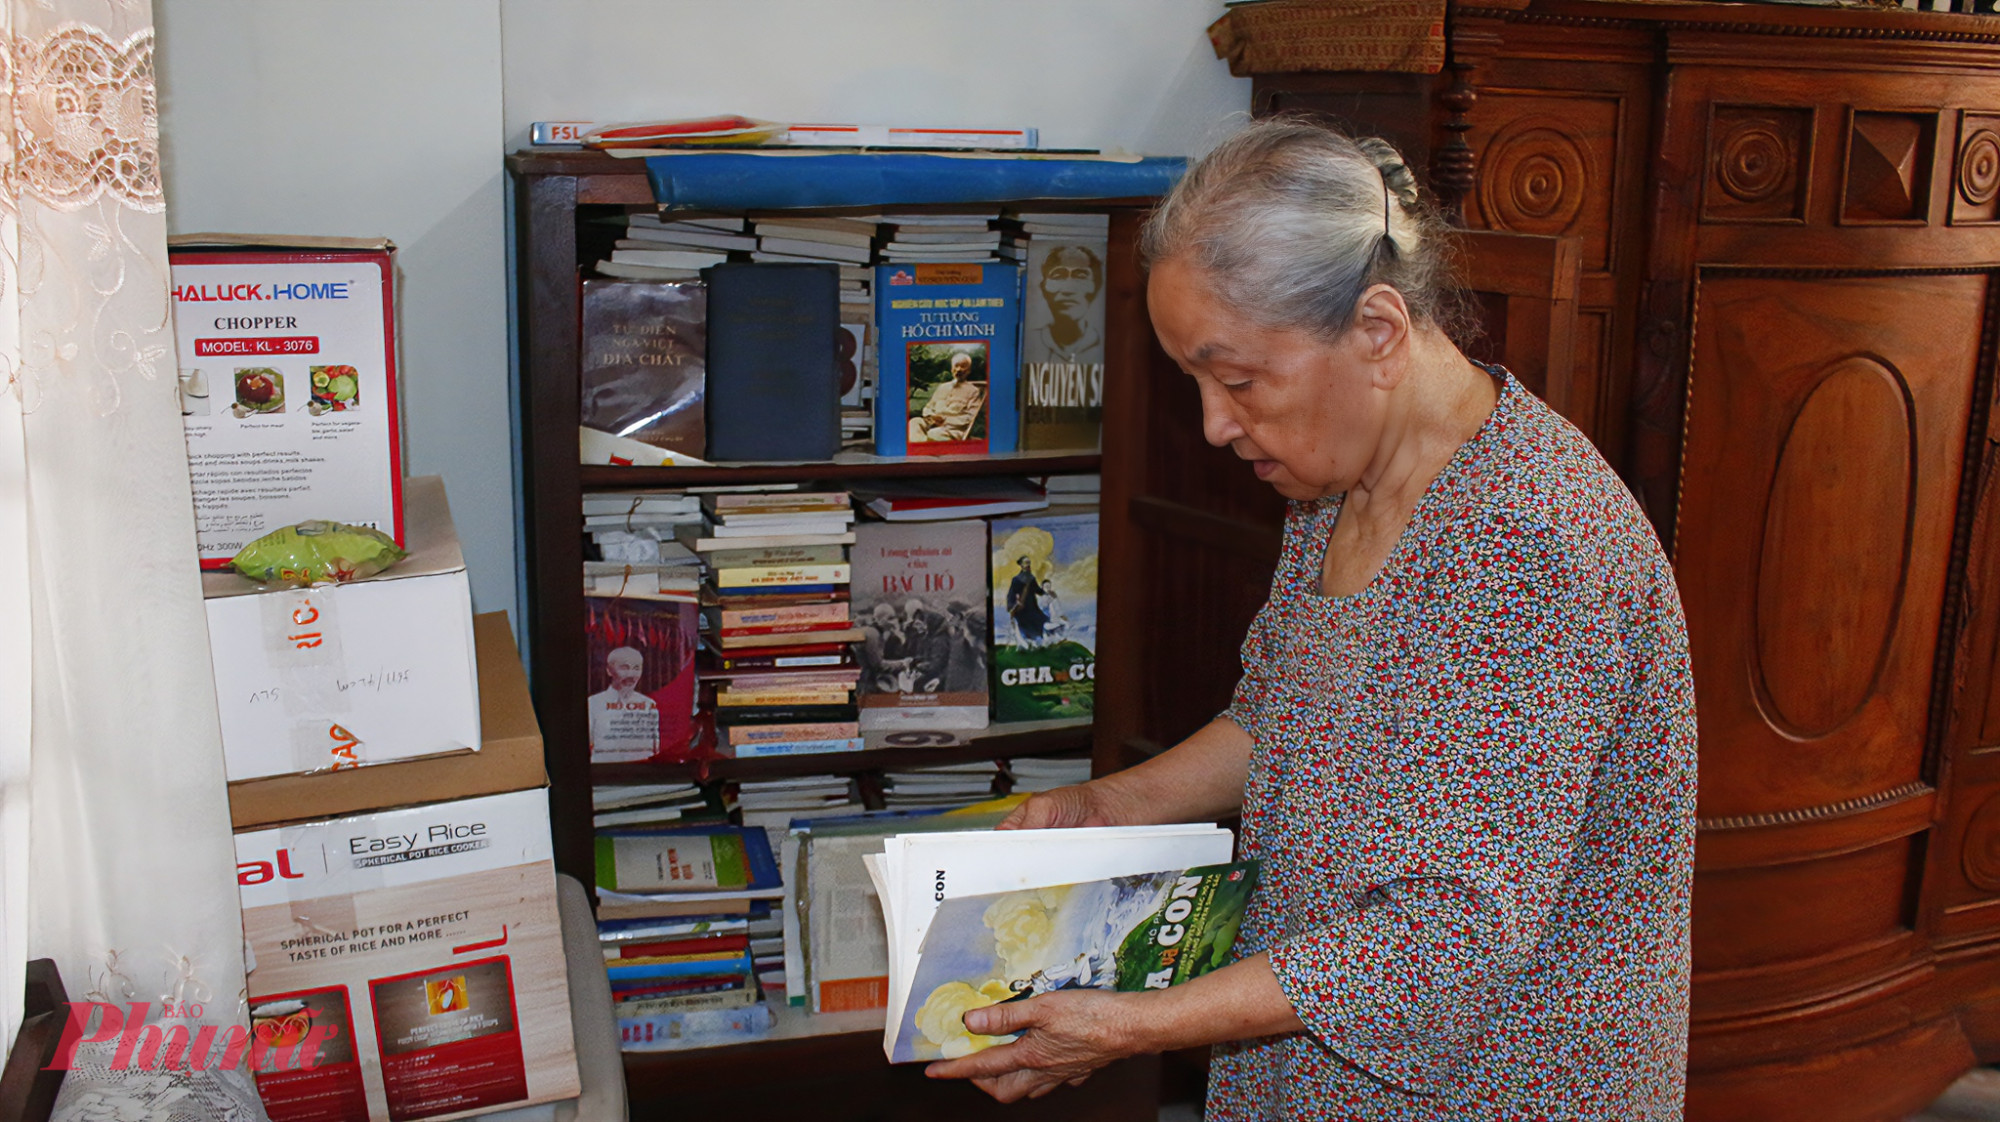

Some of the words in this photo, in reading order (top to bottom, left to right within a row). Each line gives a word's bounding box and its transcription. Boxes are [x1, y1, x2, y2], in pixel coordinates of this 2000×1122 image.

[214, 316, 298, 330] CHOPPER
[954, 323, 995, 337] MINH
[202, 341, 253, 353] MODEL:
[256, 340, 273, 351] KL
[283, 340, 313, 351] 3076
[217, 541, 243, 551] 300W
[1001, 666, 1054, 686] CHA
[349, 831, 418, 856] Easy
[428, 820, 486, 843] Rice
[354, 852, 408, 868] SPHERICAL
[409, 849, 426, 861] POT
[428, 845, 449, 858] RICE
[451, 839, 489, 854] COOKER
[936, 869, 946, 902] CON
[1157, 875, 1203, 947] CON
[280, 930, 349, 951] SPHERICAL
[352, 927, 376, 940] POT
[379, 922, 403, 935] FOR
[406, 920, 415, 931] A
[417, 910, 470, 930] PERFECT
[289, 948, 327, 963] TASTE
[330, 945, 346, 957] OF
[350, 940, 377, 954] RICE
[380, 935, 406, 949] AND
[409, 929, 443, 945] MORE
